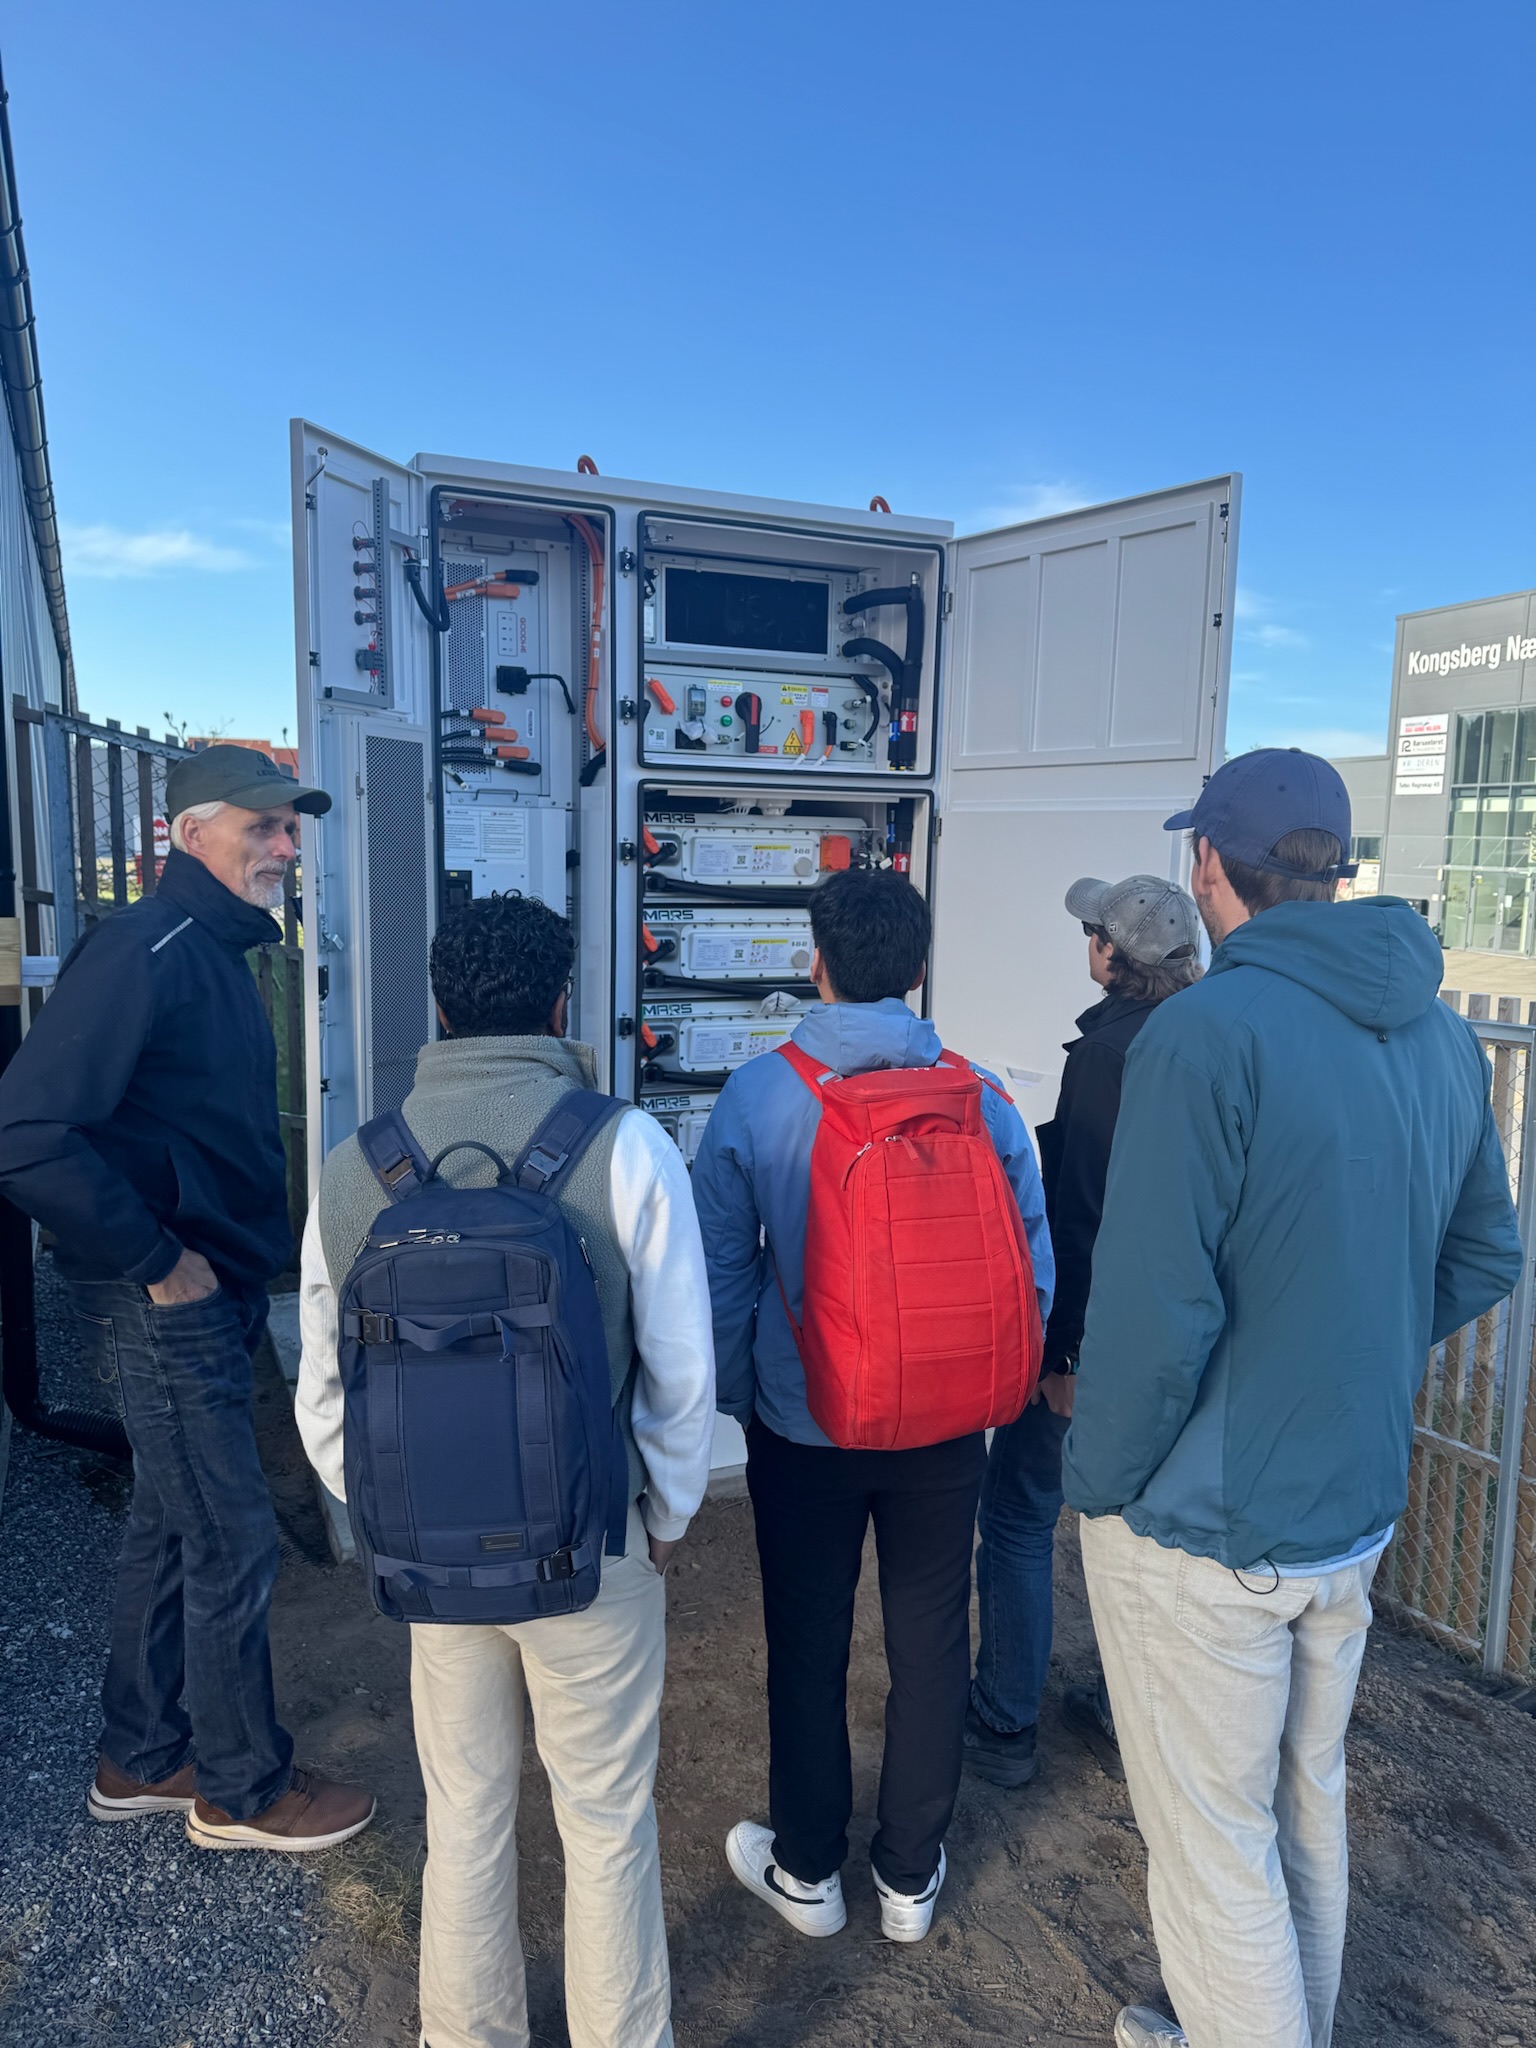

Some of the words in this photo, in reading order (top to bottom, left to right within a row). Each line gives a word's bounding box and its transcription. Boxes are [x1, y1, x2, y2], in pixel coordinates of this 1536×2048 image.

[1408, 643, 1501, 676] Kongsberg
[645, 813, 696, 824] MARS
[643, 910, 694, 921] MARS
[643, 1003, 693, 1016] MARS
[641, 1096, 691, 1110] MARS
